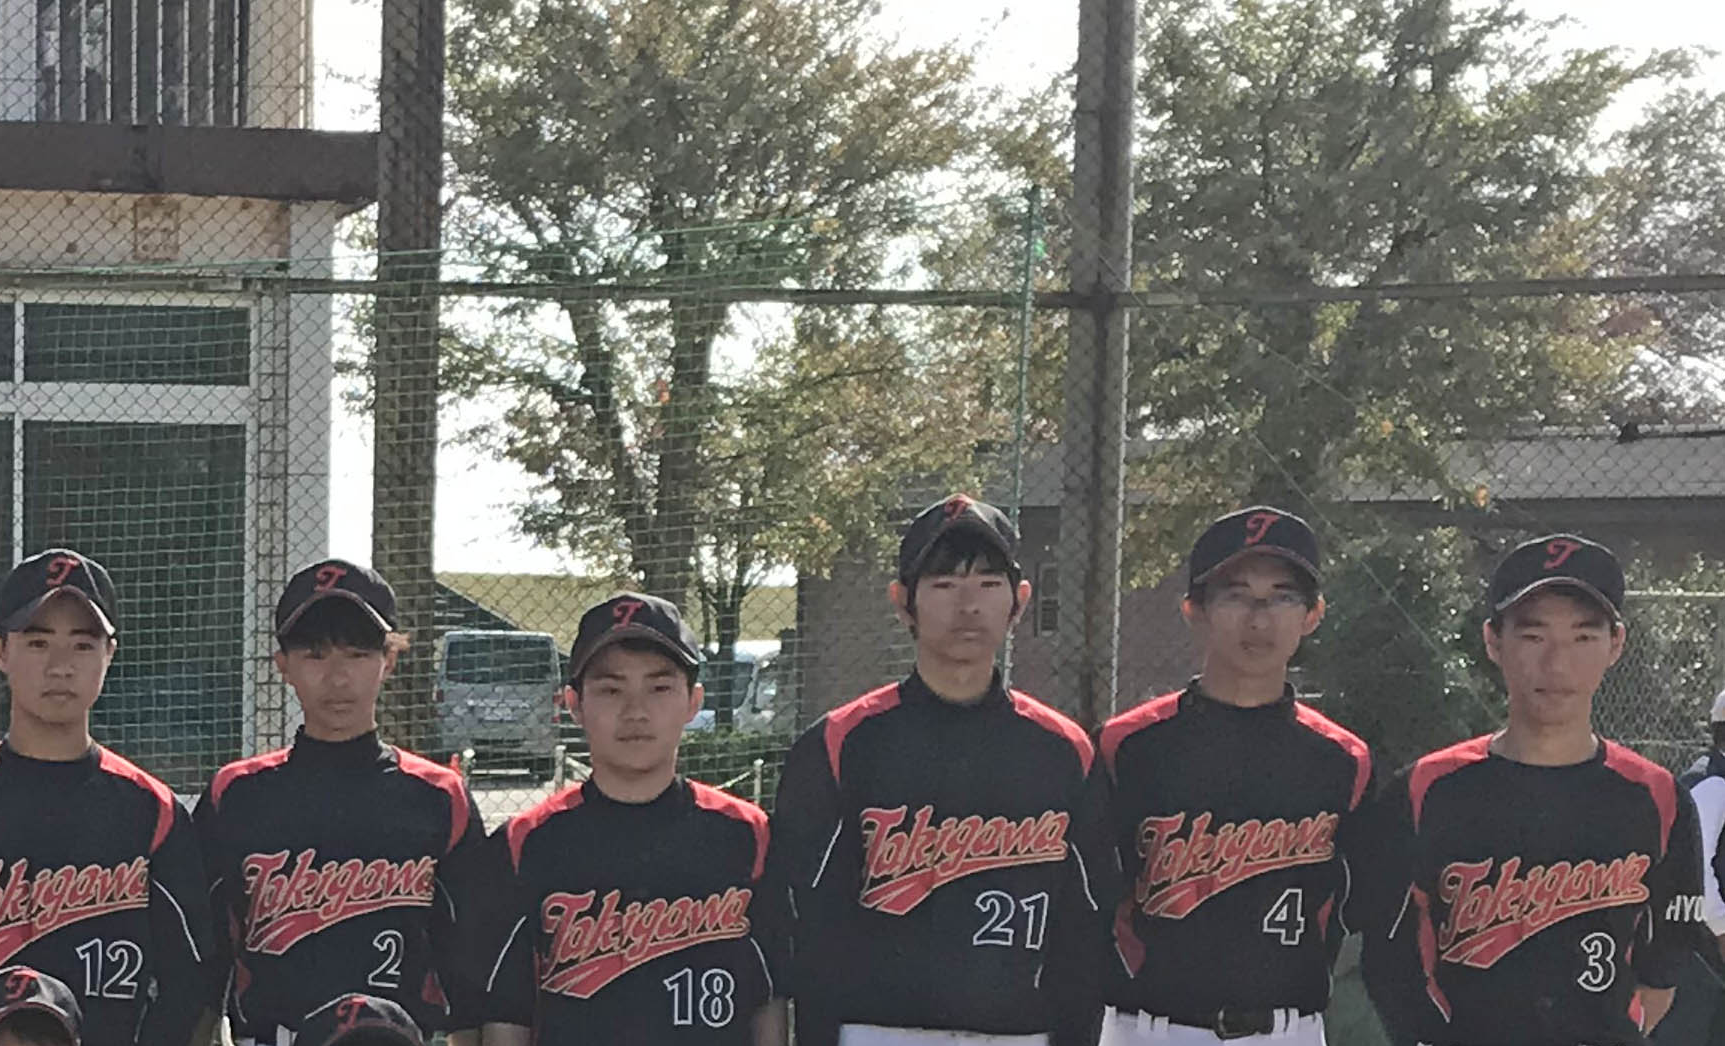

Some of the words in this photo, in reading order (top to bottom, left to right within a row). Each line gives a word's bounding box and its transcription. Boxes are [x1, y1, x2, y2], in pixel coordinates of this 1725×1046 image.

[1246, 512, 1280, 545] T
[1543, 540, 1580, 570] T
[45, 556, 80, 586] T
[313, 565, 348, 593] T
[612, 599, 645, 630] T
[860, 805, 1070, 898] Takigawa
[1137, 811, 1339, 904] Takigawa
[242, 849, 439, 936] Takigawa
[972, 890, 1049, 950] 21
[1263, 888, 1306, 946] 4
[1440, 852, 1651, 949] Takigawa
[368, 930, 405, 988] 2
[540, 885, 754, 978] Takigawa
[75, 938, 143, 999] 12
[1577, 932, 1616, 992] 3
[663, 968, 735, 1027] 18
